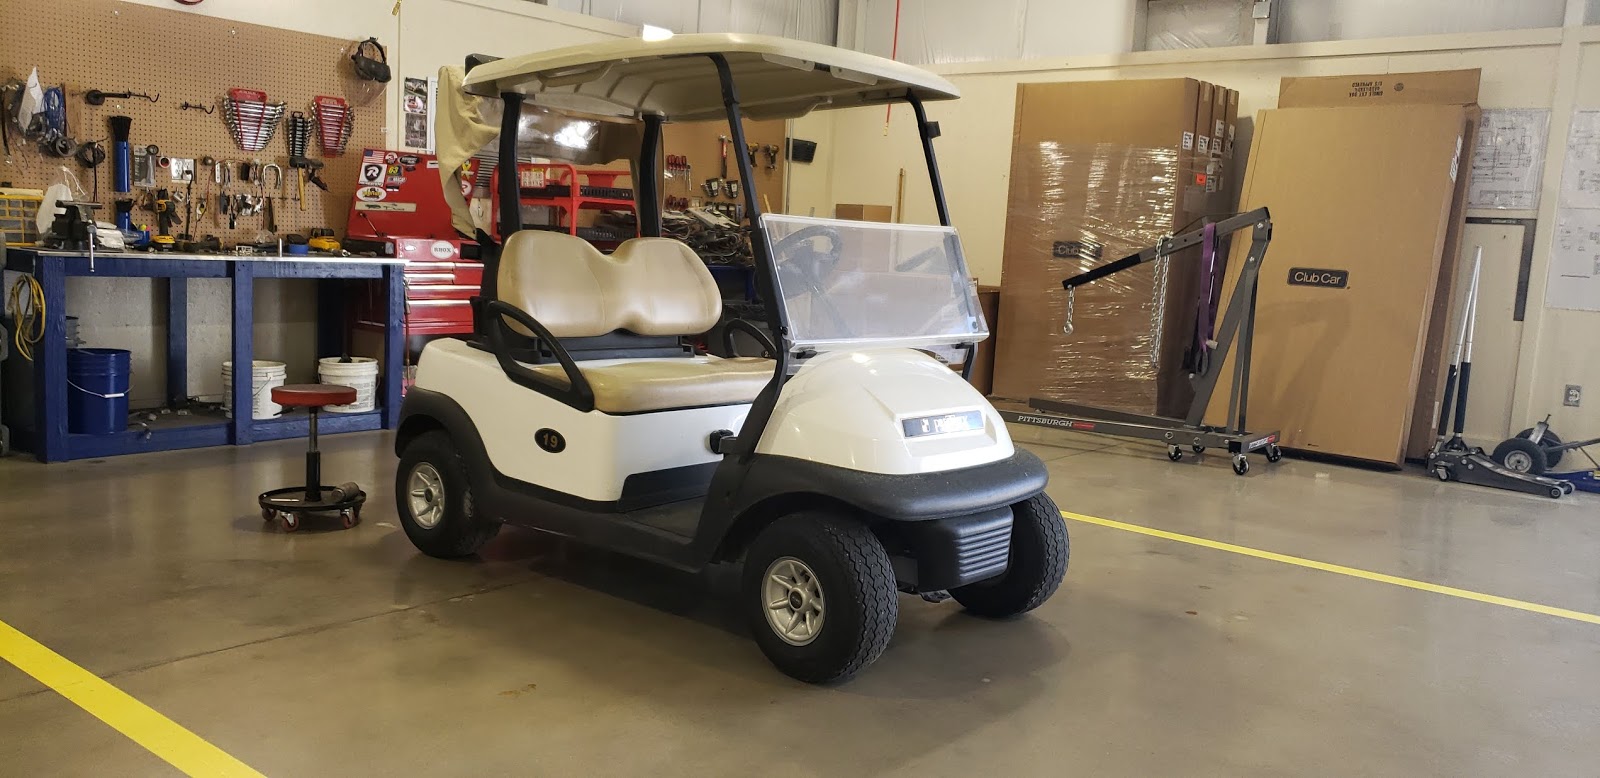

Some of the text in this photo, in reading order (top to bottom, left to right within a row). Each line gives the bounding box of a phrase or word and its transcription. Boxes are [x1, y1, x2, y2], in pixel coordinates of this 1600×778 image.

[1294, 271, 1342, 285] Club Car
[1017, 415, 1073, 427] PITTSBURGH
[543, 432, 558, 449] 19
